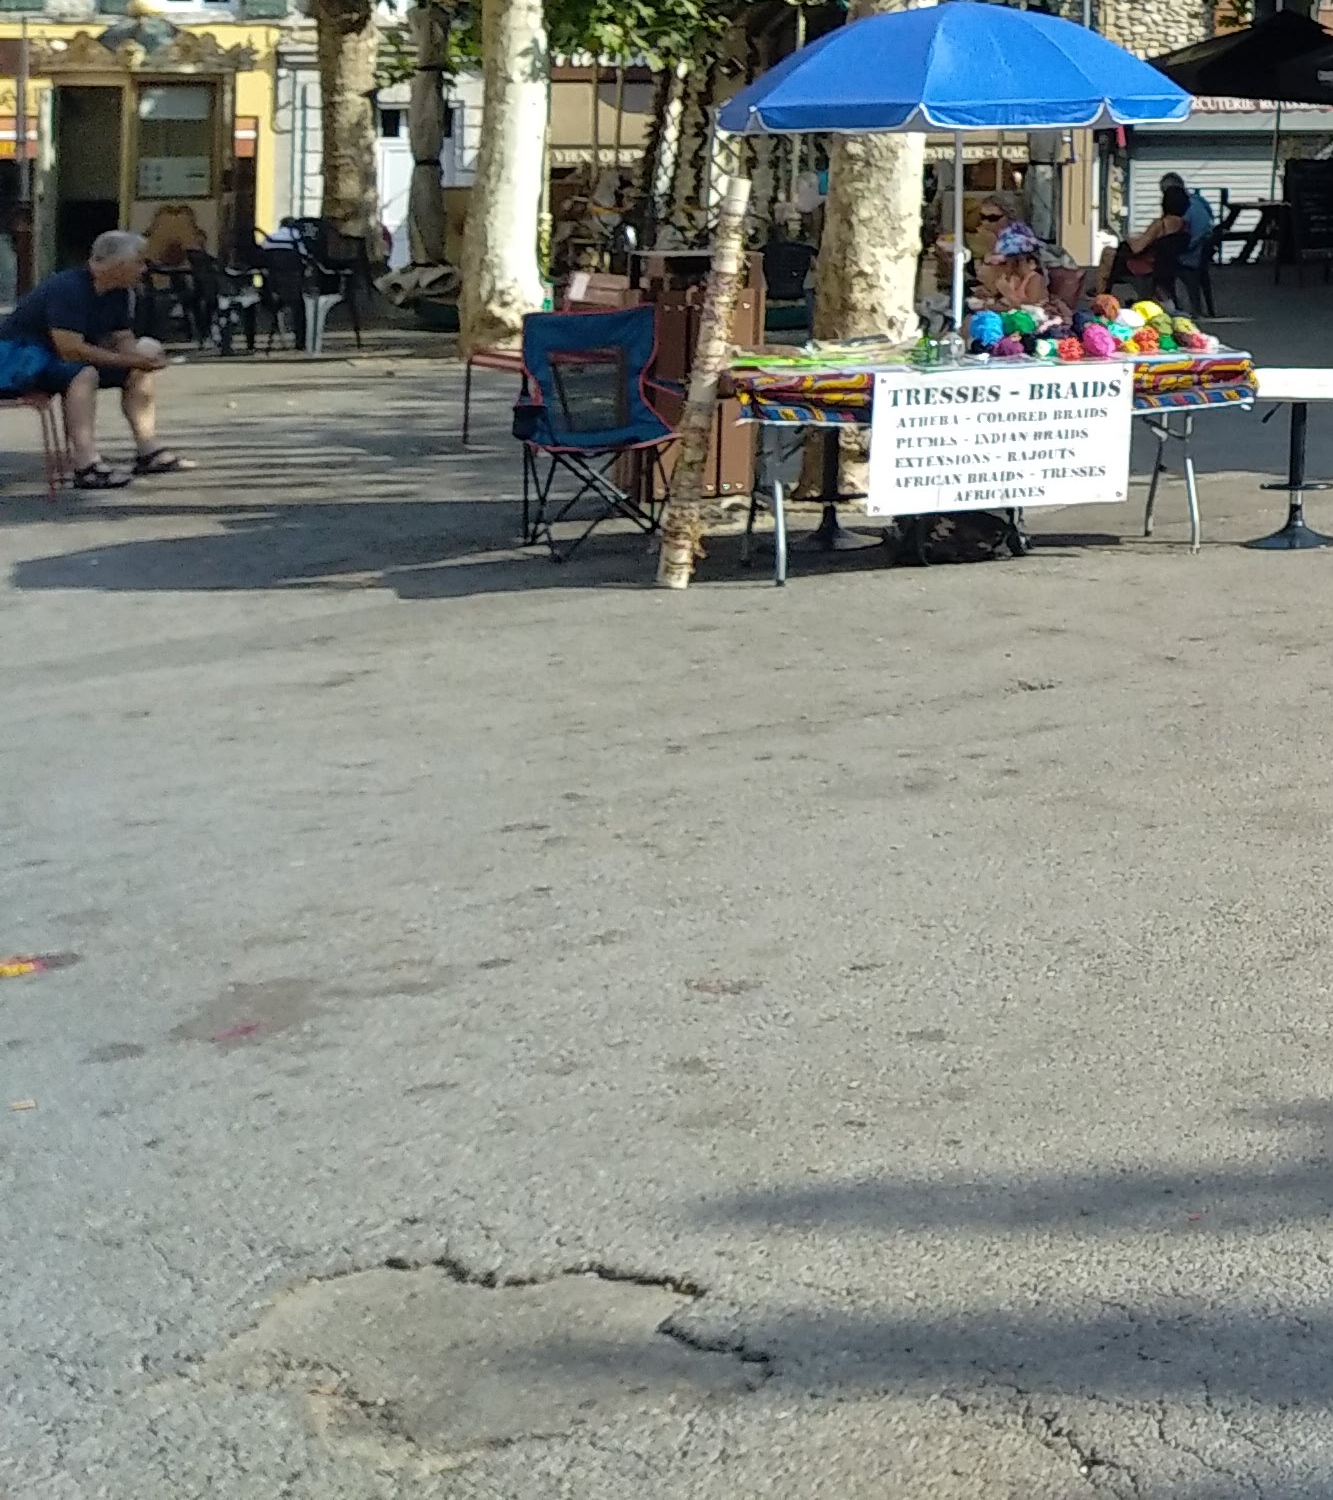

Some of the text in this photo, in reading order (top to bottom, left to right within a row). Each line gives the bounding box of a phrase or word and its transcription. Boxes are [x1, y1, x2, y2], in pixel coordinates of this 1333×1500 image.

[888, 385, 1002, 407] TRESSES
[1028, 379, 1122, 401] BRAIDS
[976, 410, 1048, 424] COLORED
[1052, 407, 1108, 420] BRAIDS
[896, 436, 958, 449] PLUMES
[974, 431, 1029, 445] INDIAN
[1033, 428, 1089, 441] BRAIDS
[895, 452, 991, 469] EXTENSIONS
[1007, 448, 1076, 463] RAJOUTS
[895, 472, 961, 488] AFRICAN
[967, 470, 1024, 484] BRAIDS
[1040, 465, 1107, 480] TRESSES
[953, 485, 1046, 503] AFRICAINES
